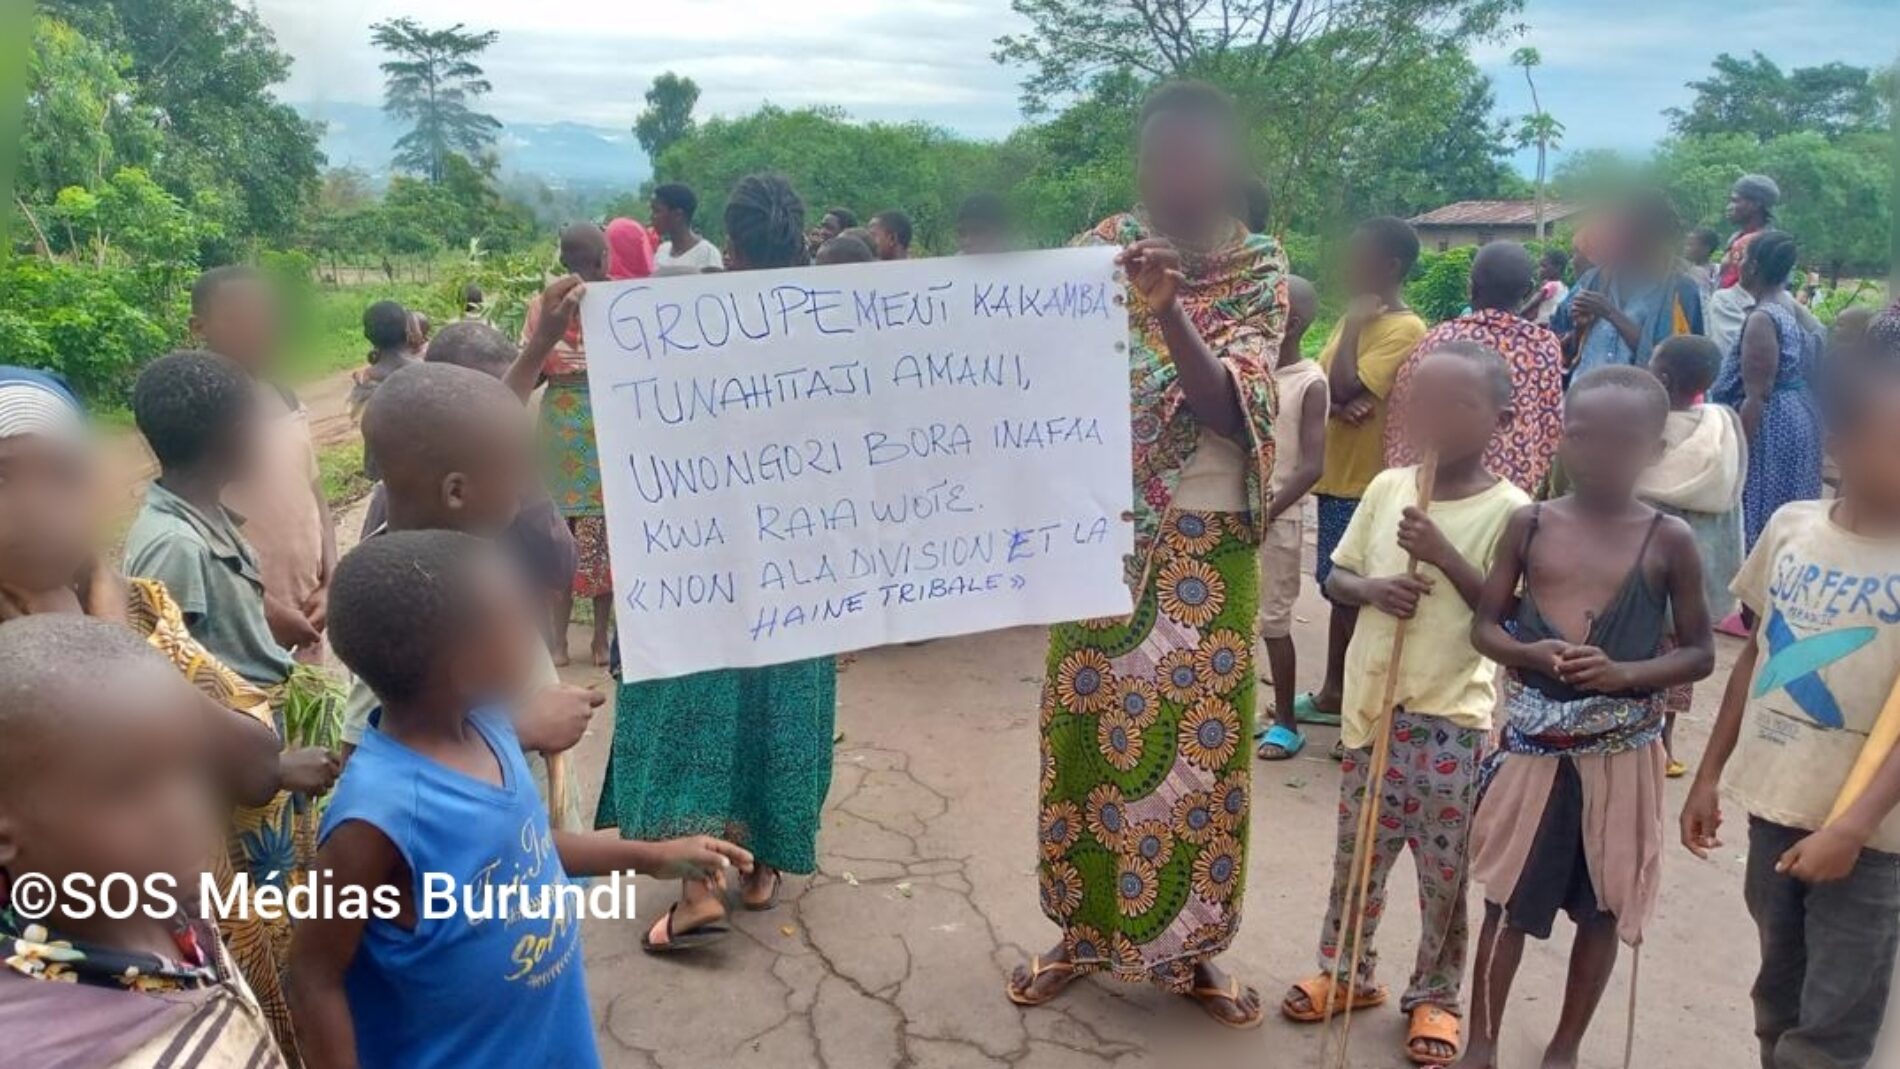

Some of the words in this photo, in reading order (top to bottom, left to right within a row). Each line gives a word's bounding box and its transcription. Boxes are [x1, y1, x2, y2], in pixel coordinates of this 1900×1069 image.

[608, 281, 952, 359] GROUPEMENT
[973, 282, 1109, 319] KAKAMBA
[892, 353, 1031, 391] AMANI,
[864, 421, 972, 466] BORA
[994, 416, 1103, 448] INAFAA
[642, 516, 726, 554] KWA
[757, 498, 858, 540] RAIA
[871, 477, 984, 523] WOTE.
[1003, 524, 1062, 563] ET
[1073, 517, 1109, 544] LA
[1769, 553, 1900, 624] SURFERS
[750, 592, 867, 641] HAINE
